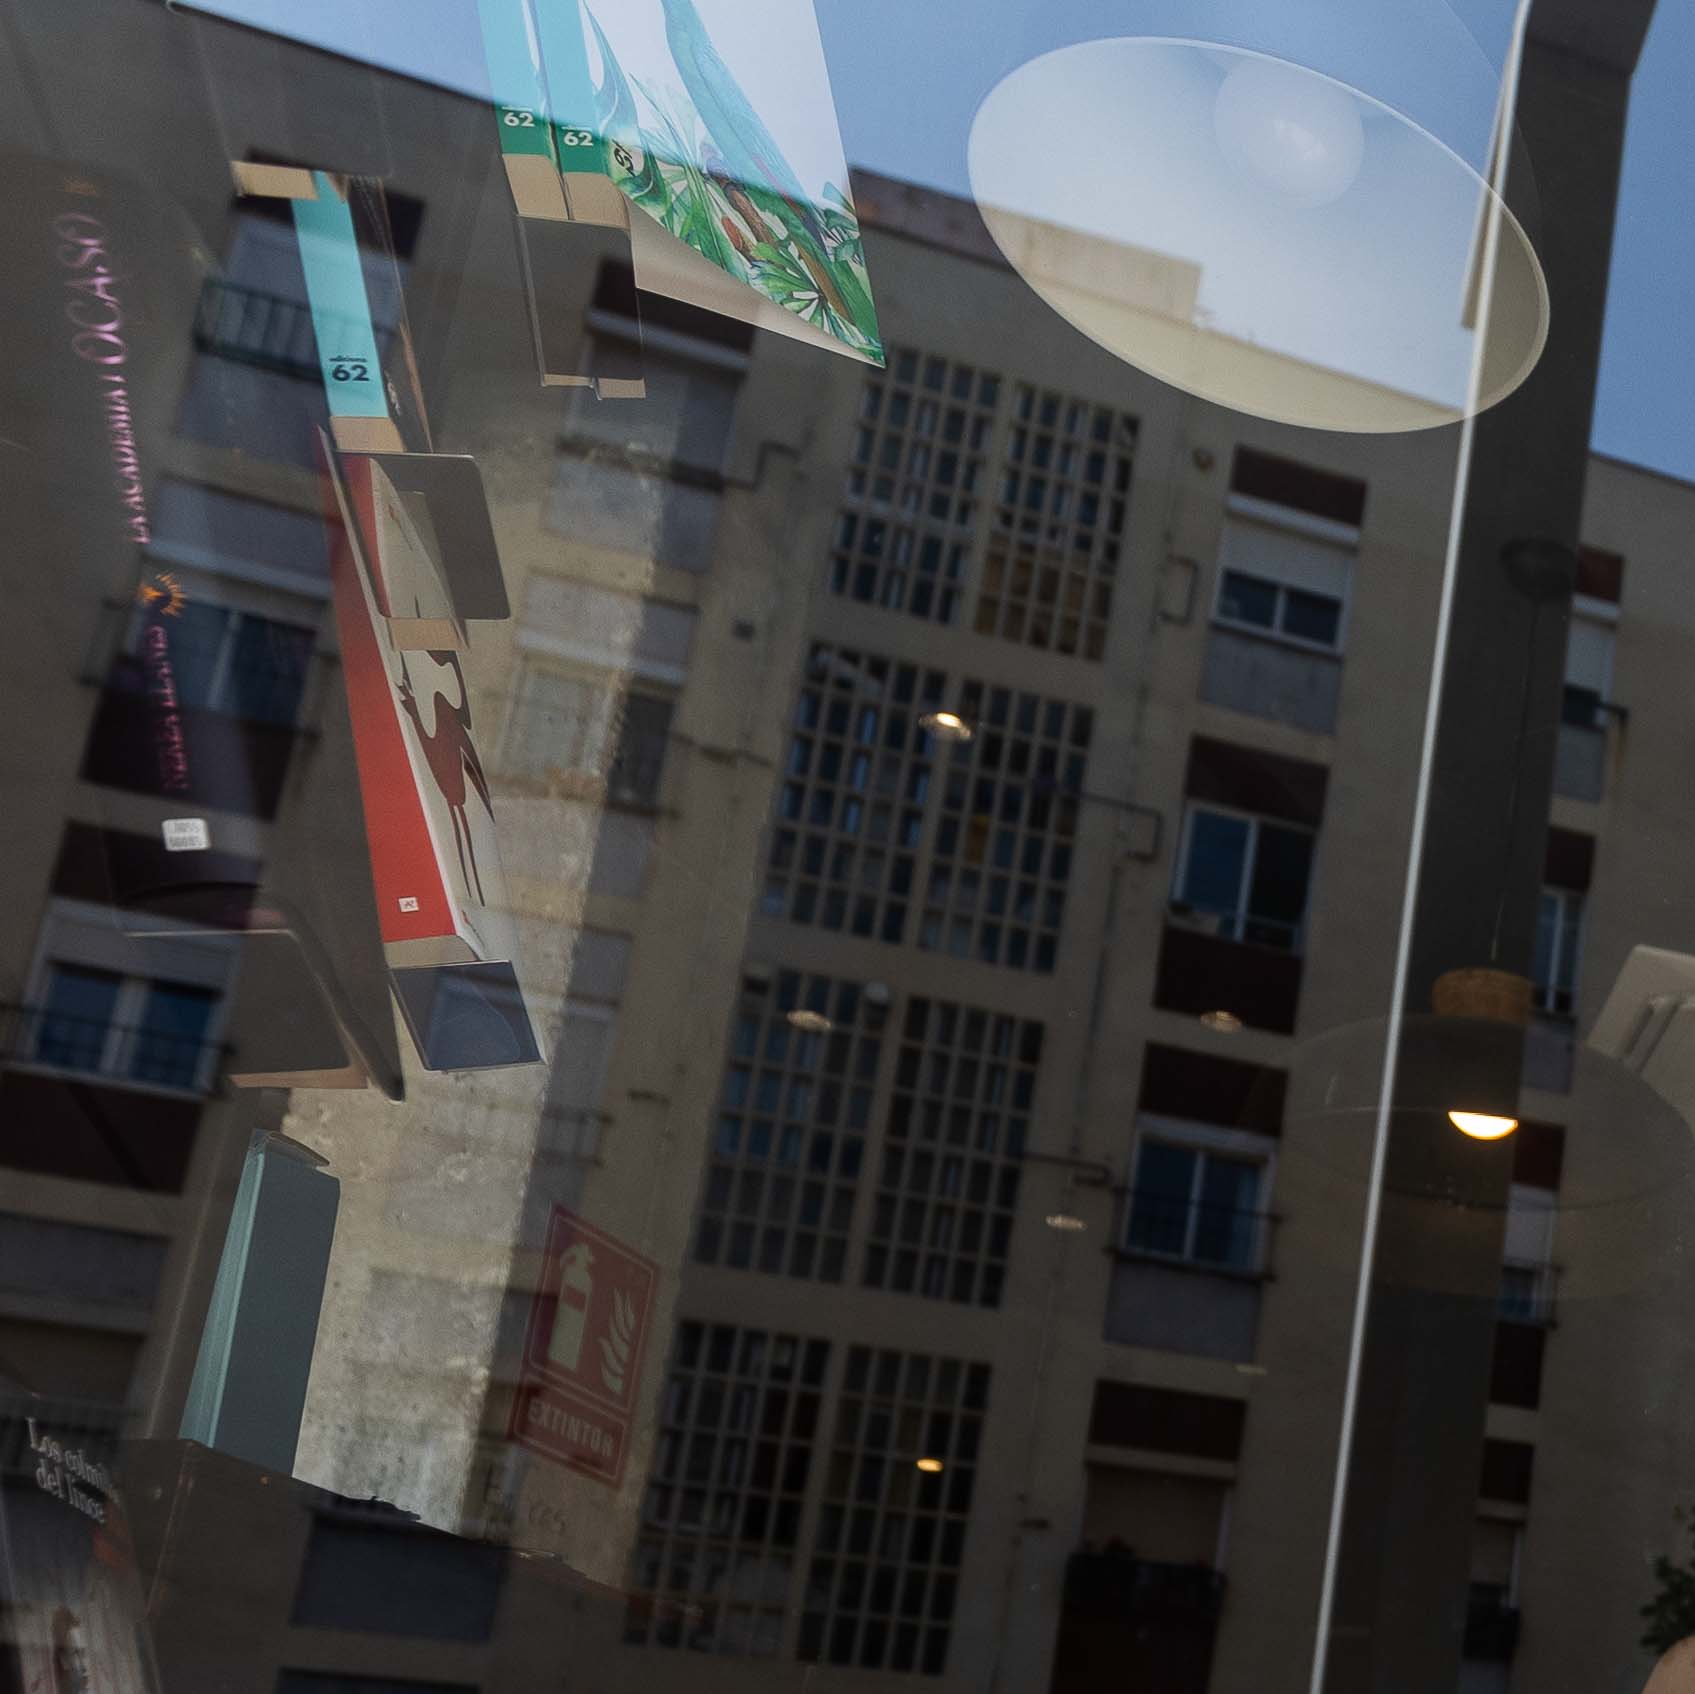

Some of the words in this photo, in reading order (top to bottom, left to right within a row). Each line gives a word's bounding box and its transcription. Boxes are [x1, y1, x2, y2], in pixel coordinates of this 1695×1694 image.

[504, 113, 535, 127] 62
[564, 132, 594, 146] 62
[332, 364, 370, 381] 62
[528, 1399, 615, 1457] EXTINTOR
[26, 1416, 62, 1464] Los
